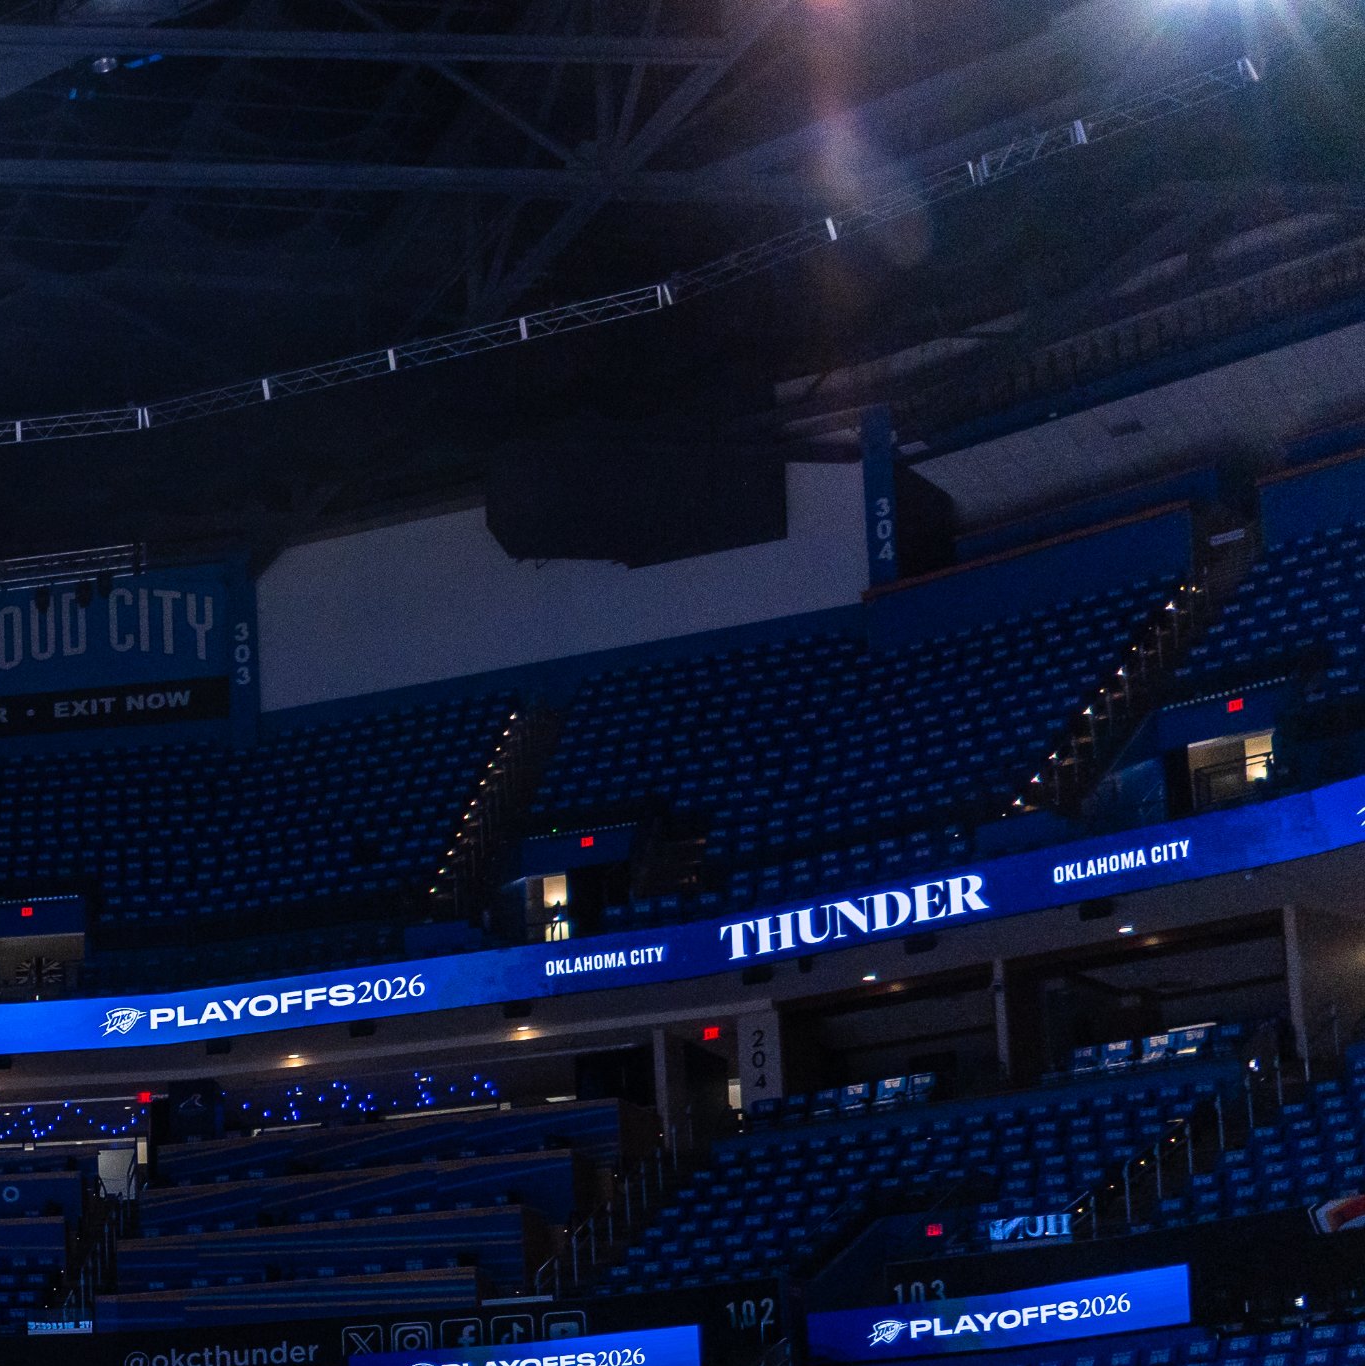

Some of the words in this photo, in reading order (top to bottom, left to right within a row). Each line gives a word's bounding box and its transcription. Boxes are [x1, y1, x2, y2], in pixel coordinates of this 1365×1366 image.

[876, 498, 894, 560] 304
[109, 588, 213, 659] CITY
[235, 623, 250, 684] 303
[54, 697, 116, 717] EXIT
[126, 691, 190, 711] NOW
[1054, 850, 1147, 883] OKLAHOMA
[1151, 840, 1189, 863] CITY
[721, 875, 988, 959] THUNDER
[546, 952, 625, 976] OKLAHOMA
[630, 947, 663, 965] CITY
[752, 1029, 767, 1089] 204
